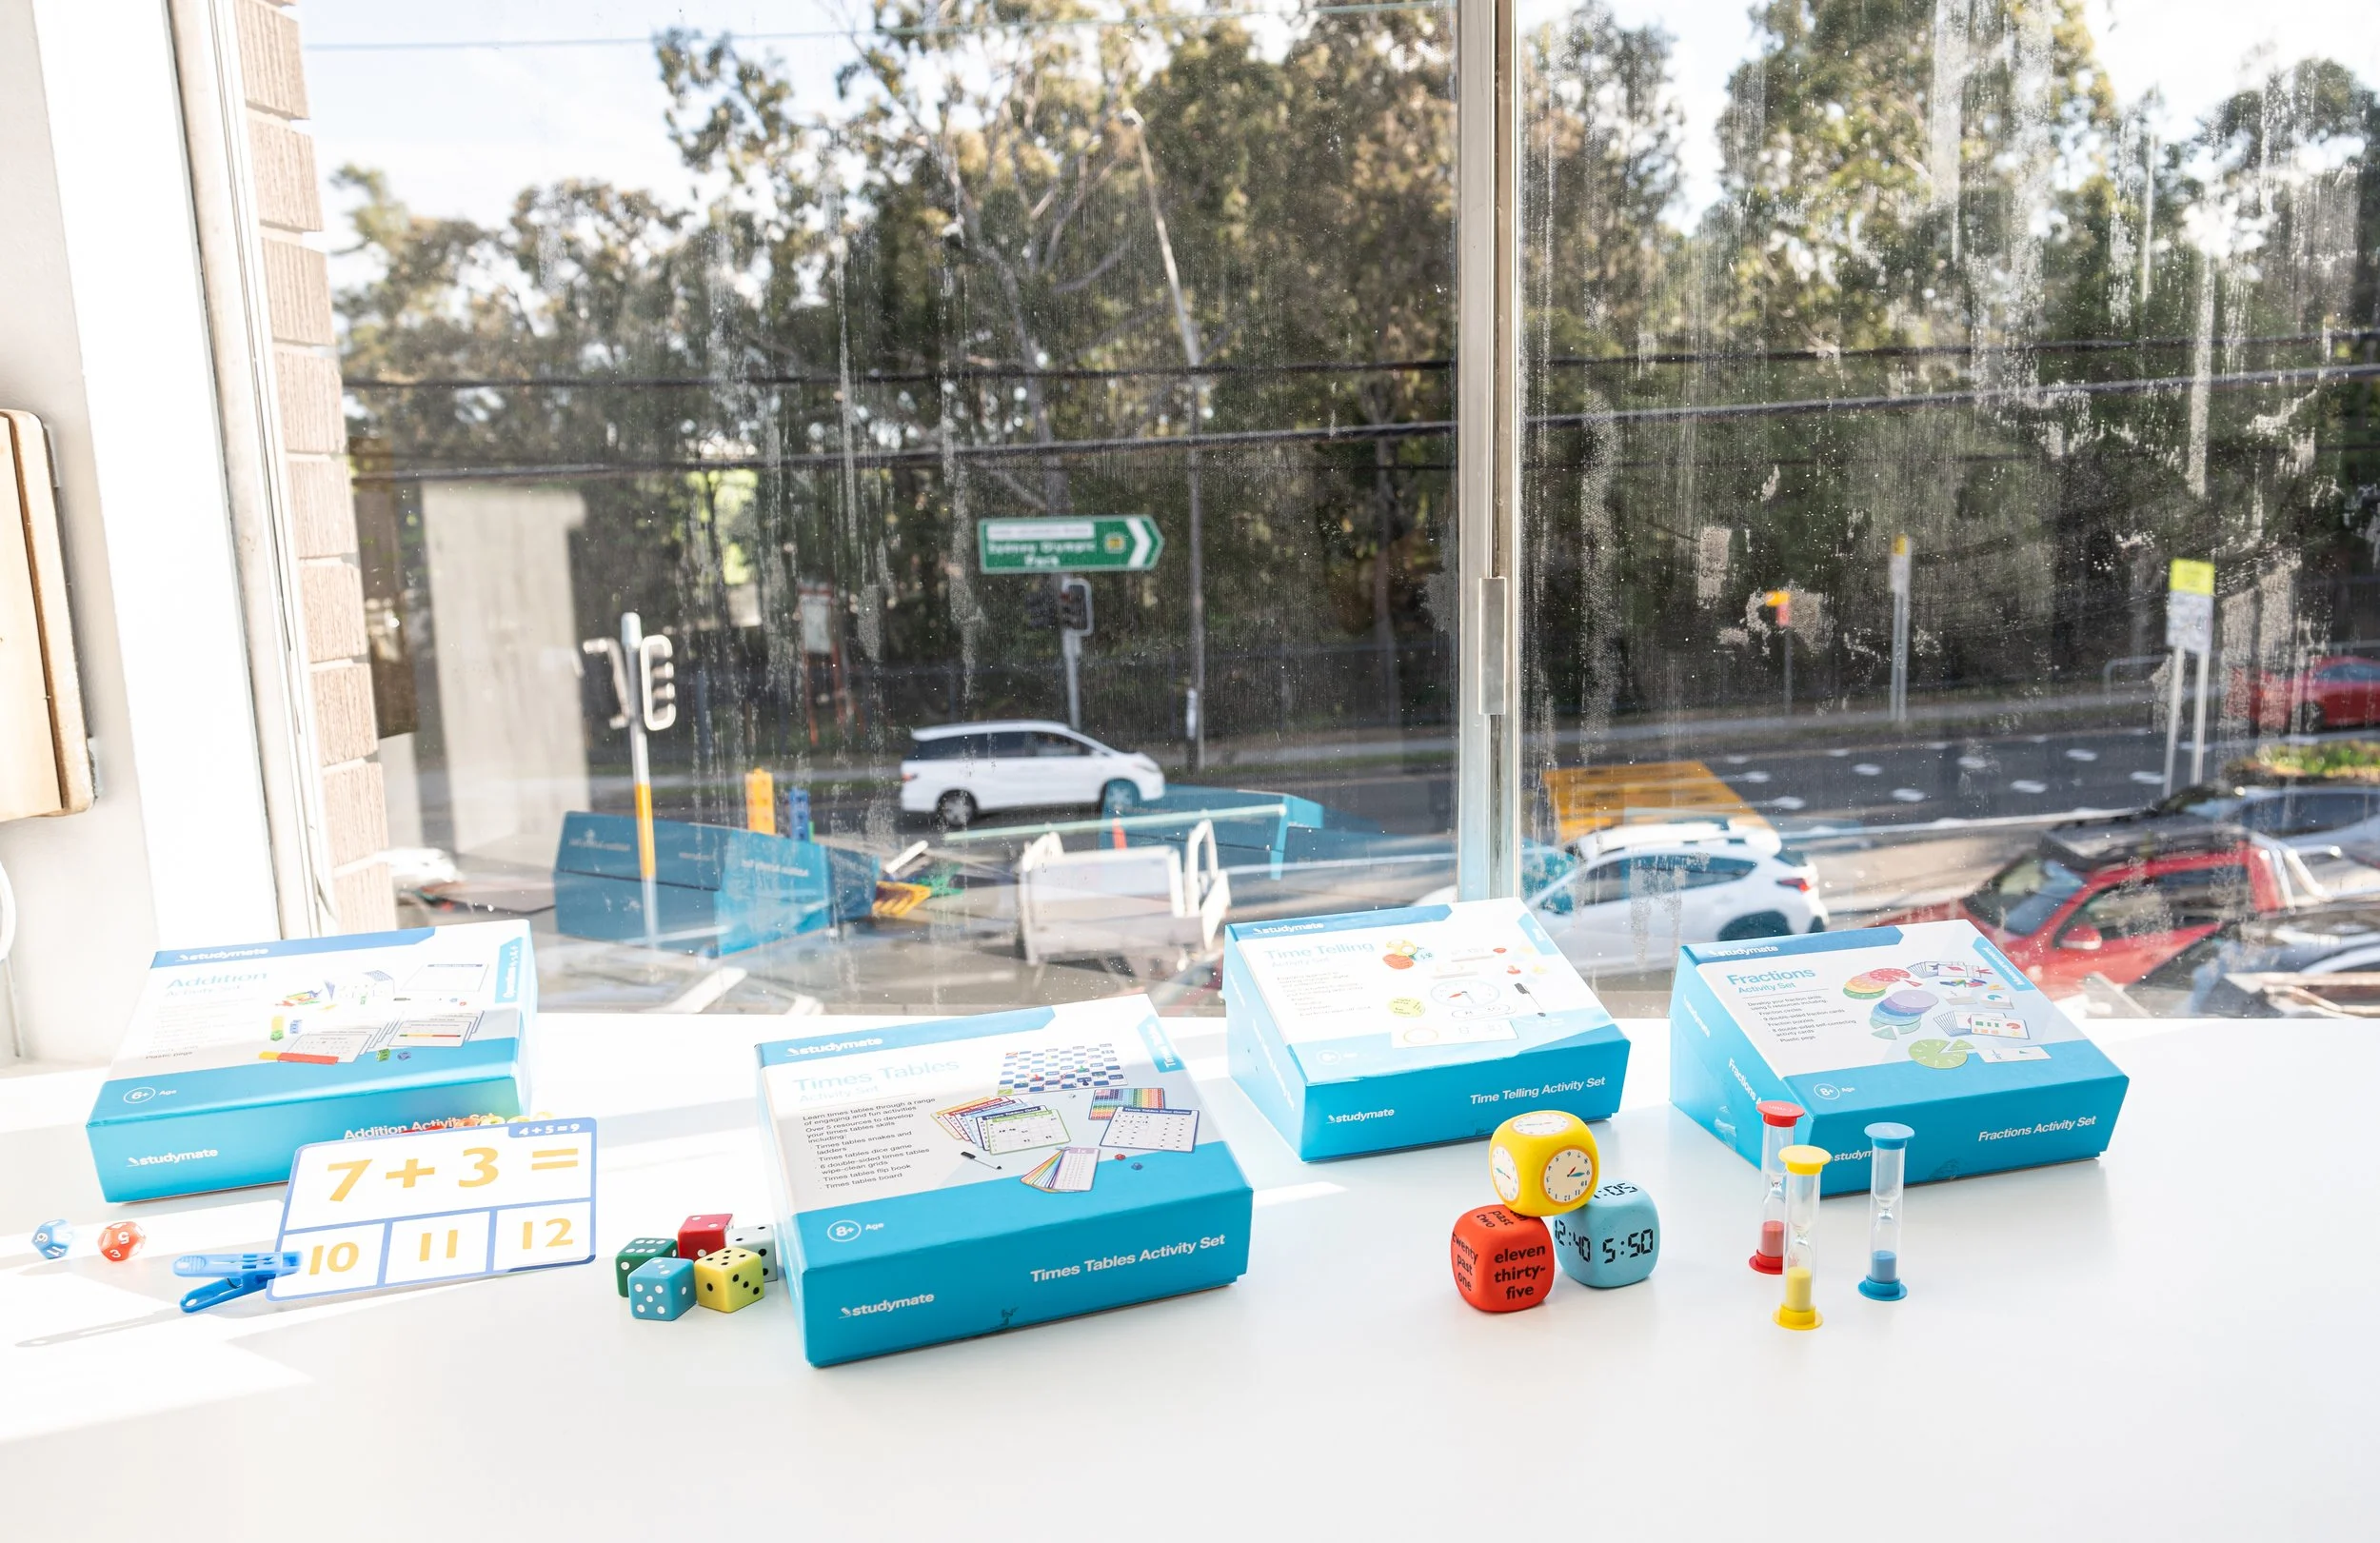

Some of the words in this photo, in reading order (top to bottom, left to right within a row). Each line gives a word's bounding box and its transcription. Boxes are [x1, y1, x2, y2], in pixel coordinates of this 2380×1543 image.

[1259, 922, 1325, 934] studymate
[1264, 948, 1312, 959] Time
[1317, 941, 1375, 956] Telling
[1716, 945, 1779, 958] studymate
[167, 972, 268, 990] Addition
[1726, 968, 1816, 986] Fractions
[1738, 982, 1776, 995] Activity
[1777, 981, 1796, 990] Set
[799, 1037, 883, 1056] studymate
[793, 1072, 873, 1092] Times
[878, 1059, 960, 1080] Tables
[1728, 1057, 1756, 1101] Fractions
[130, 1091, 149, 1100] 6+
[1470, 1092, 1499, 1105] Time
[1502, 1087, 1539, 1100] Telling
[1541, 1080, 1584, 1095] Activity
[1586, 1076, 1606, 1089] Set
[1820, 1087, 1835, 1097] 8+
[1336, 1108, 1395, 1123] studymate
[343, 1123, 407, 1141] Addition
[570, 1123, 580, 1133] 9
[1978, 1127, 2032, 1142] Fractions
[2033, 1119, 2075, 1135] Activity
[2076, 1116, 2096, 1127] Set
[139, 1148, 219, 1167] studymate
[1835, 1148, 1874, 1162] studym
[327, 1158, 373, 1202] 7
[458, 1146, 500, 1188] 3
[1477, 1214, 1496, 1228] two
[1488, 1211, 1514, 1226] past
[522, 1217, 574, 1250] 12
[835, 1225, 854, 1236] 8+
[865, 1222, 884, 1231] Age
[419, 1229, 459, 1262] 11
[1452, 1231, 1478, 1264] twenty
[1555, 1219, 1591, 1263] 12:40
[1602, 1229, 1654, 1264] 5:50
[109, 1249, 121, 1258] 3
[308, 1241, 360, 1276] 10
[1030, 1269, 1081, 1282] Times
[1083, 1255, 1136, 1272] Tables
[1139, 1240, 1197, 1262] Activity
[1200, 1234, 1226, 1250] Set
[1494, 1244, 1546, 1263] eleven
[1457, 1254, 1473, 1275] past
[1458, 1273, 1472, 1292] one
[1494, 1265, 1546, 1283] thirty-
[1506, 1286, 1535, 1300] five
[852, 1294, 936, 1316] studymate
